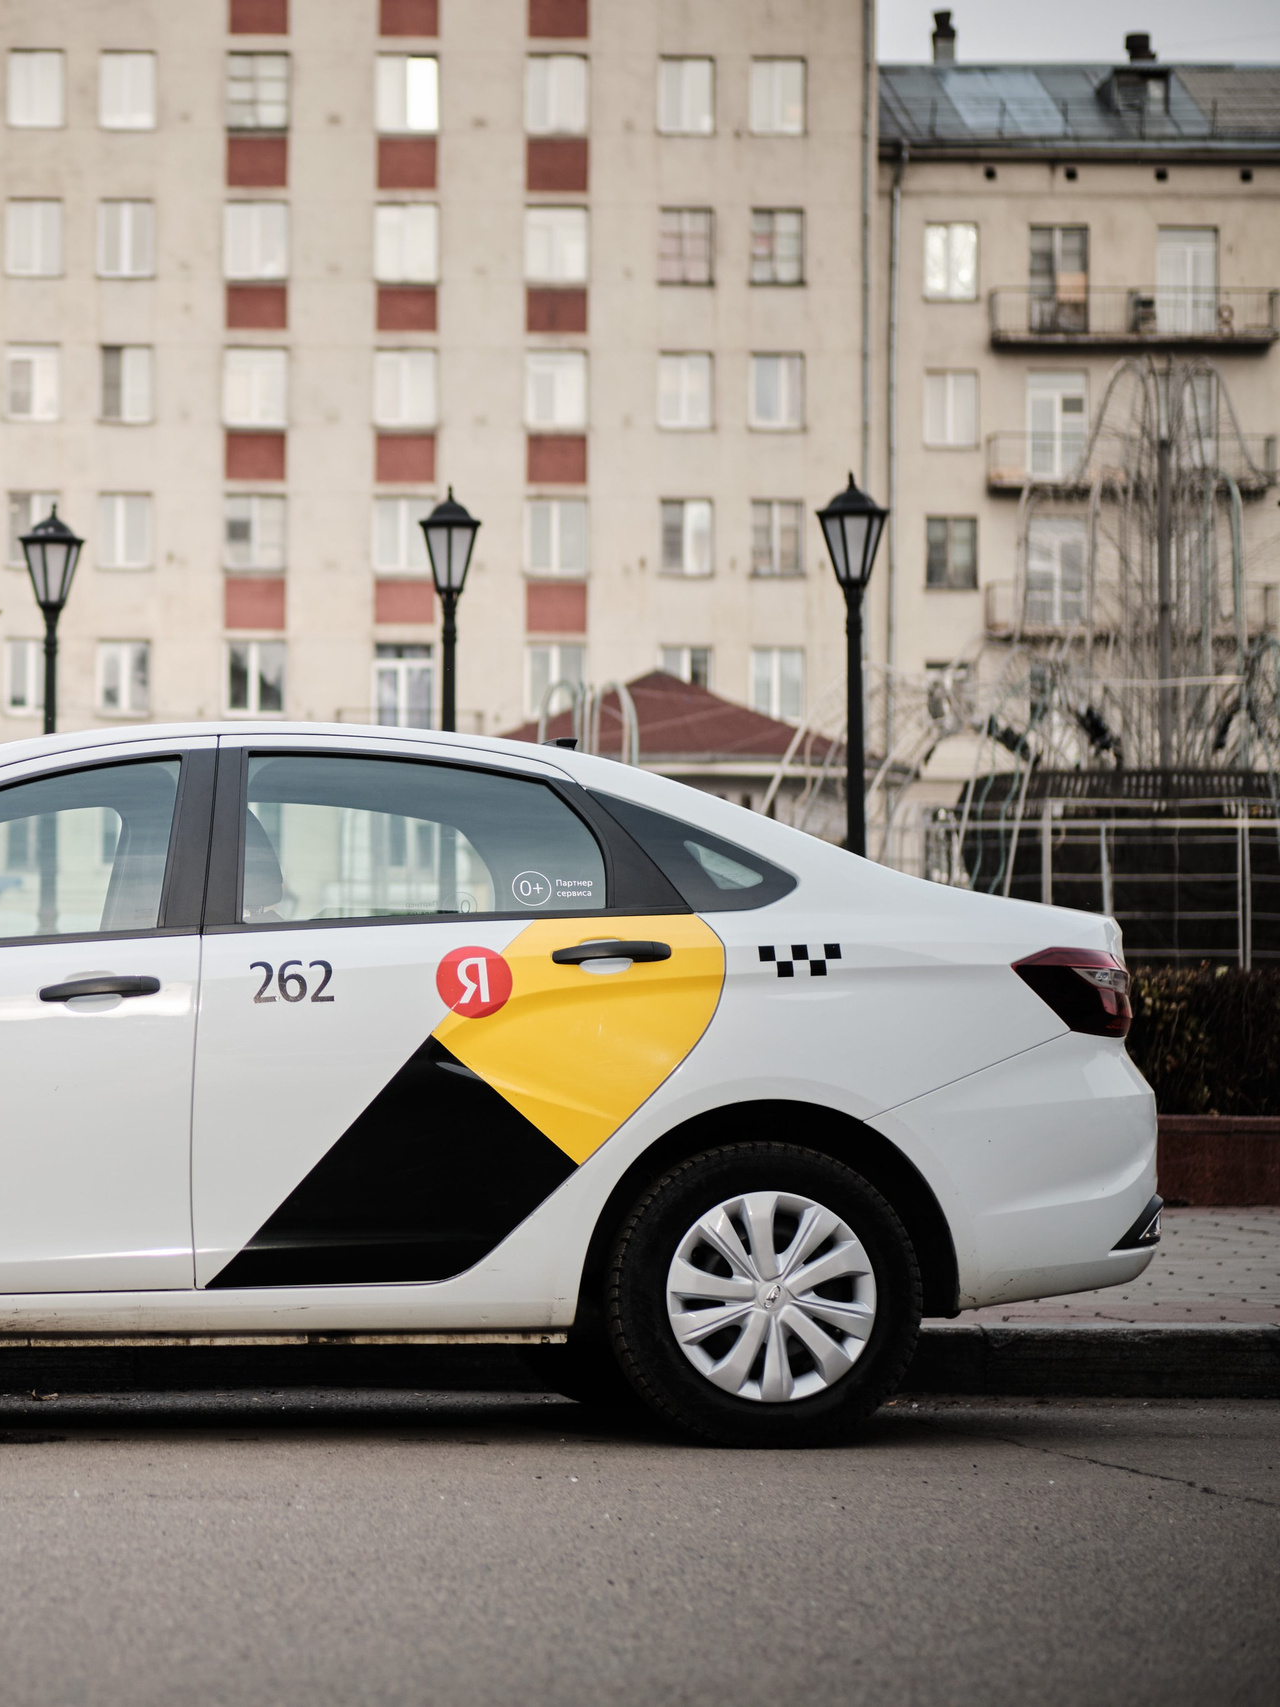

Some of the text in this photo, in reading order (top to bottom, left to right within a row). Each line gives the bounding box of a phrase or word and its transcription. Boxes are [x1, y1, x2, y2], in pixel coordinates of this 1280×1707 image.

[519, 880, 544, 897] 0+
[555, 879, 594, 888] Партнер
[556, 890, 592, 898] сервиса
[249, 959, 336, 1004] 262
[456, 957, 491, 1005] Я
